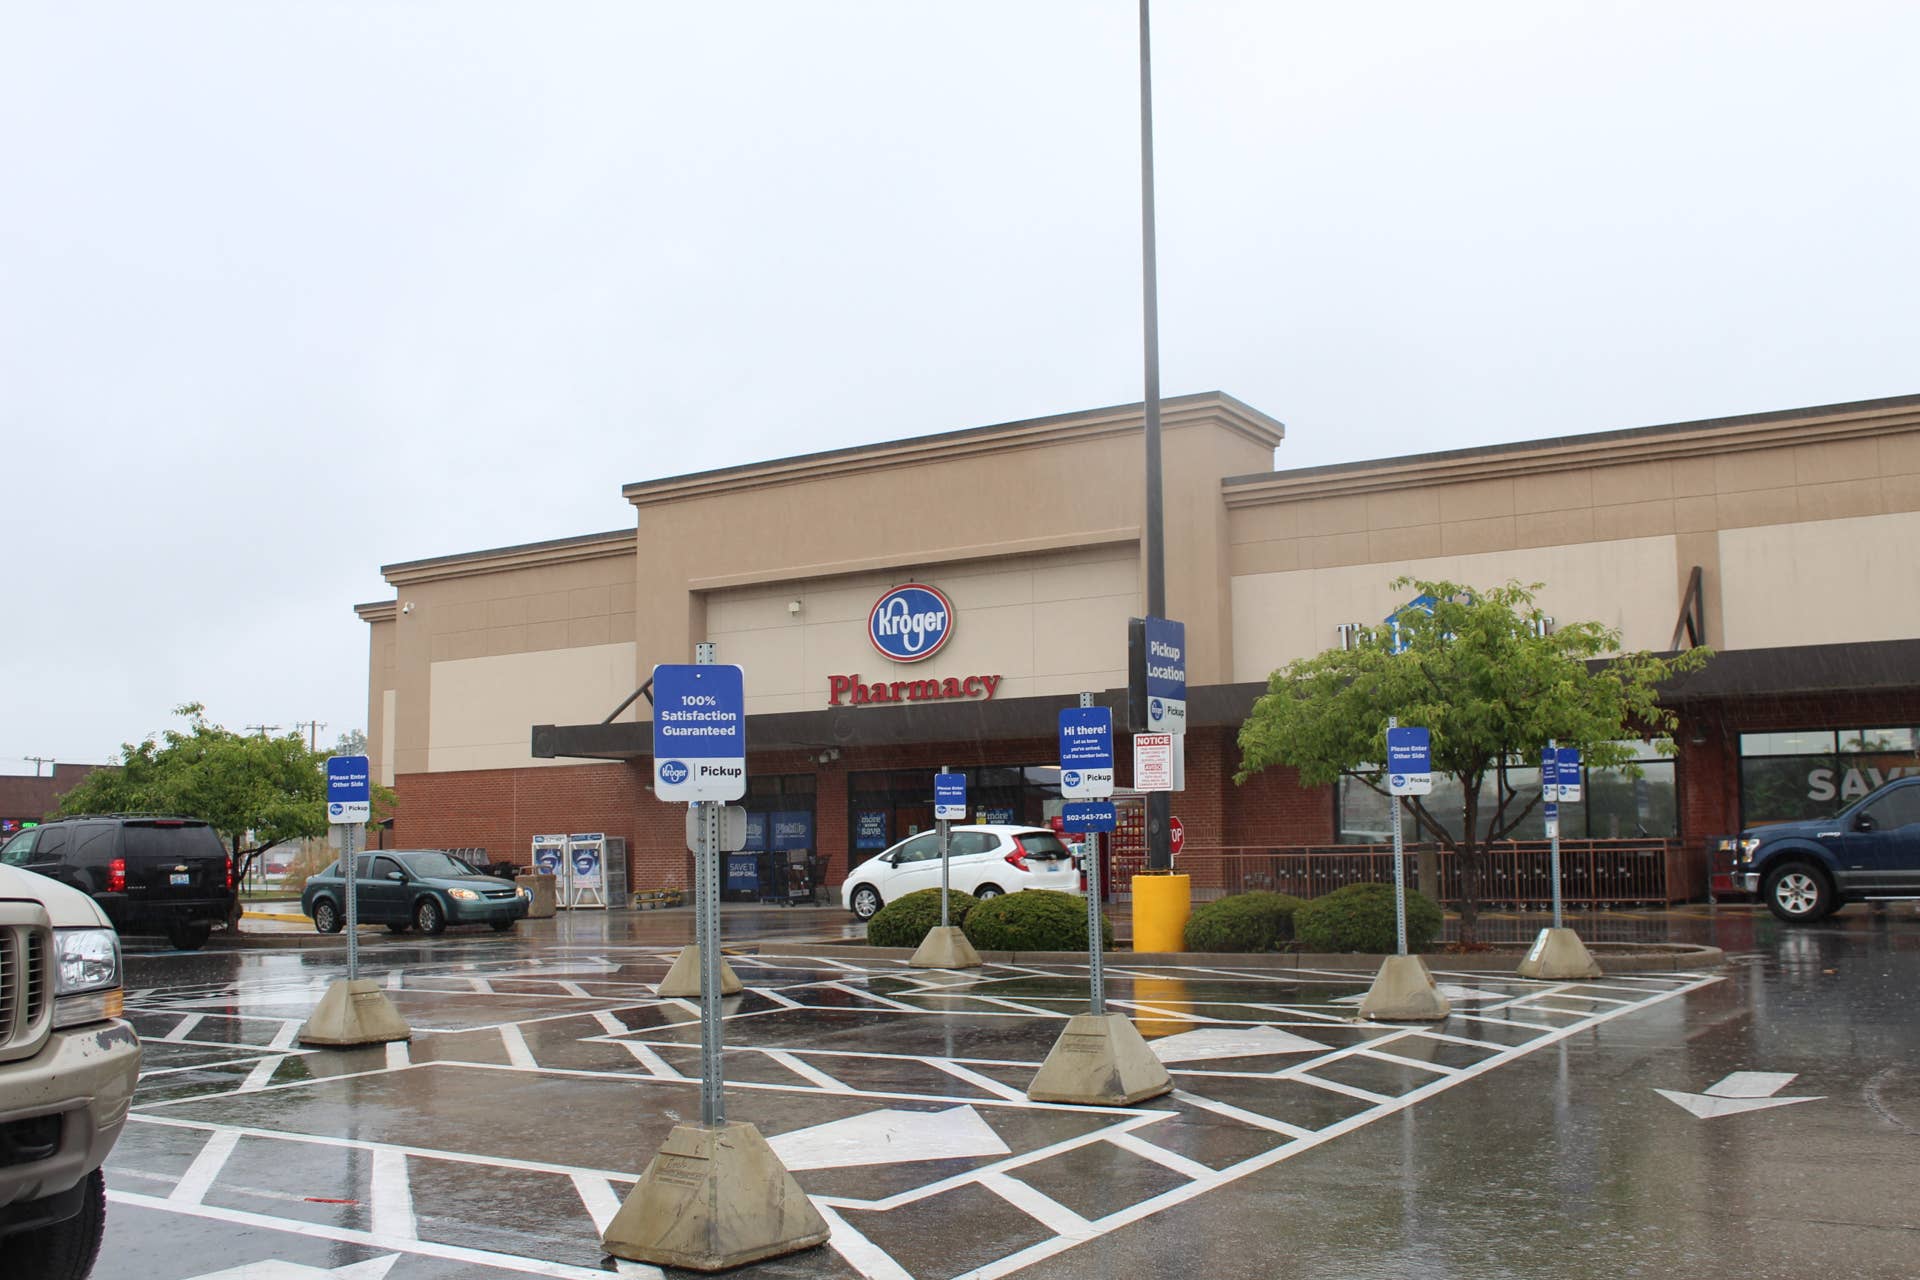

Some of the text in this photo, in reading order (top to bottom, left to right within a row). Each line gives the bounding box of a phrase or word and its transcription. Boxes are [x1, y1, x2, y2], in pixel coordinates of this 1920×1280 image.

[878, 597, 945, 652] Kroger
[1150, 641, 1180, 662] Pickup
[1147, 662, 1185, 681] Location
[828, 674, 1002, 705] Pharmacy
[681, 695, 716, 706] 100%
[661, 711, 737, 721] Satisfaction
[662, 725, 736, 736] Guaranteed
[1064, 724, 1107, 736] Hi there!
[1137, 736, 1170, 745] NOTICE
[662, 763, 742, 783] Kroger Pickup
[1087, 774, 1111, 782] Pickup
[1807, 766, 1920, 801] SAV
[1066, 813, 1112, 821] 502-543-7243
[861, 827, 881, 835] save
